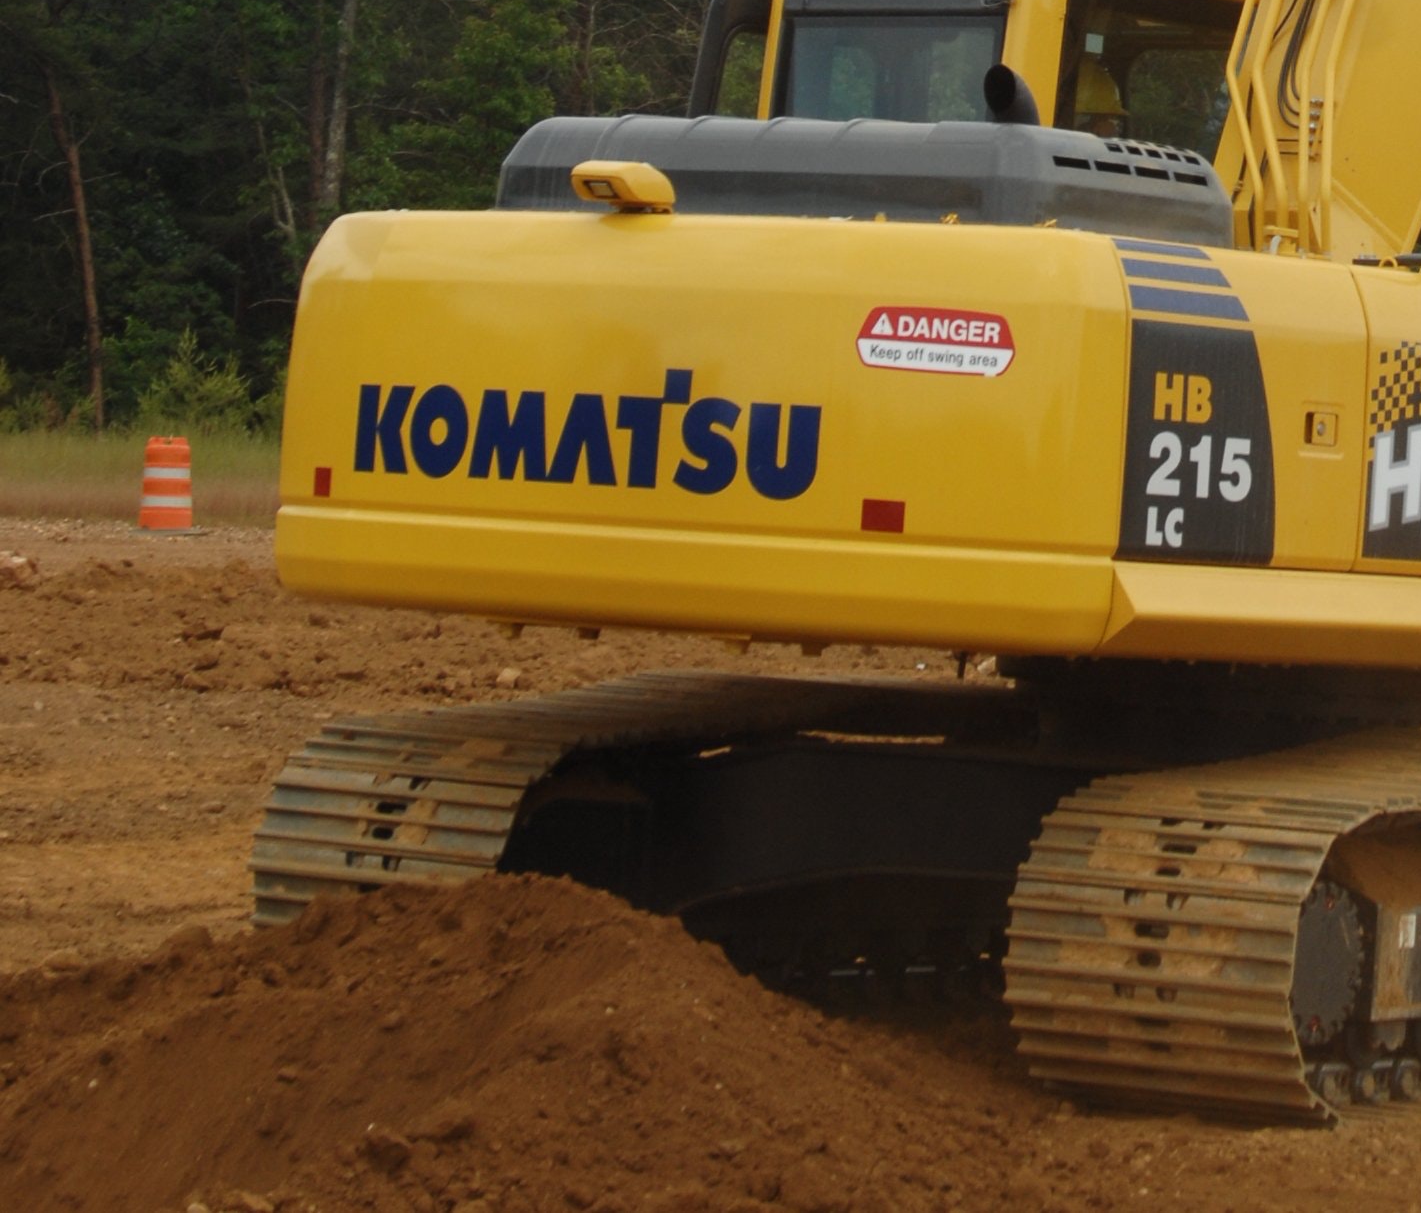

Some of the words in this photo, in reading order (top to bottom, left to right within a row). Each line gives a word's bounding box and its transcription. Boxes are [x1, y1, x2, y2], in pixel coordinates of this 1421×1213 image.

[896, 315, 1001, 344] DANGER
[869, 344, 901, 362] Keep
[906, 348, 924, 362] off
[928, 349, 964, 367] swing
[969, 354, 998, 367] area
[1153, 371, 1213, 424] HB
[353, 368, 823, 501] KOMATSU
[1146, 430, 1253, 503] 215
[1145, 506, 1184, 549] LC
